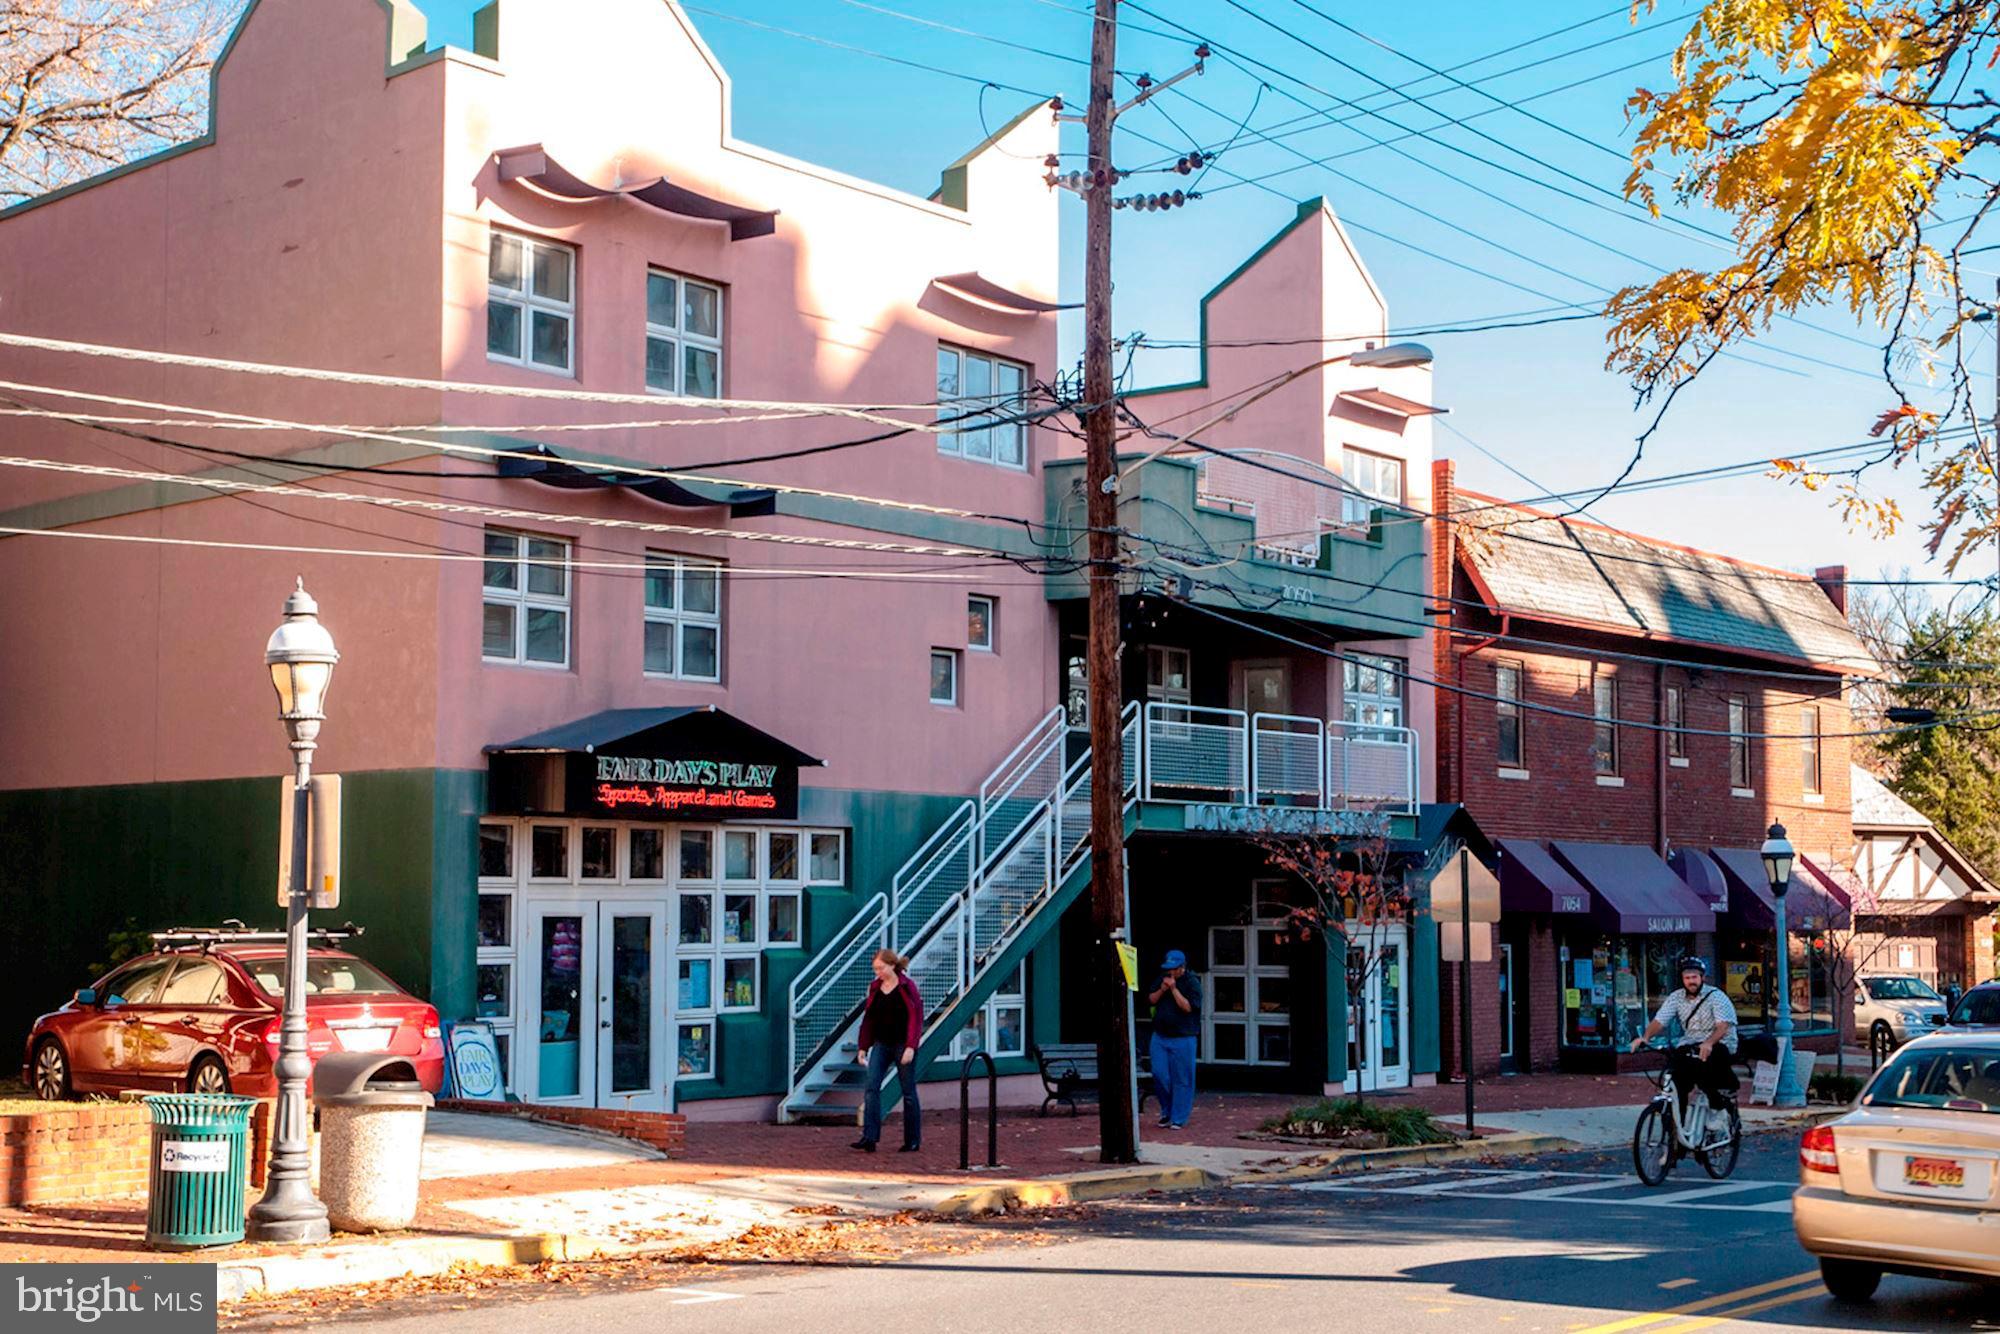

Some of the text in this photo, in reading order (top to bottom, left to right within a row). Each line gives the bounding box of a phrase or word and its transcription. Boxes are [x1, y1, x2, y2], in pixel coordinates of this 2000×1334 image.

[596, 756, 652, 782] FAIR
[719, 763, 777, 788] PLAY
[656, 786, 705, 809] Apparel
[706, 789, 732, 806] and
[733, 789, 776, 809] Games
[1561, 896, 1581, 911] 7054
[1648, 918, 1691, 932] SALON JAM
[464, 1074, 491, 1087] PLAY
